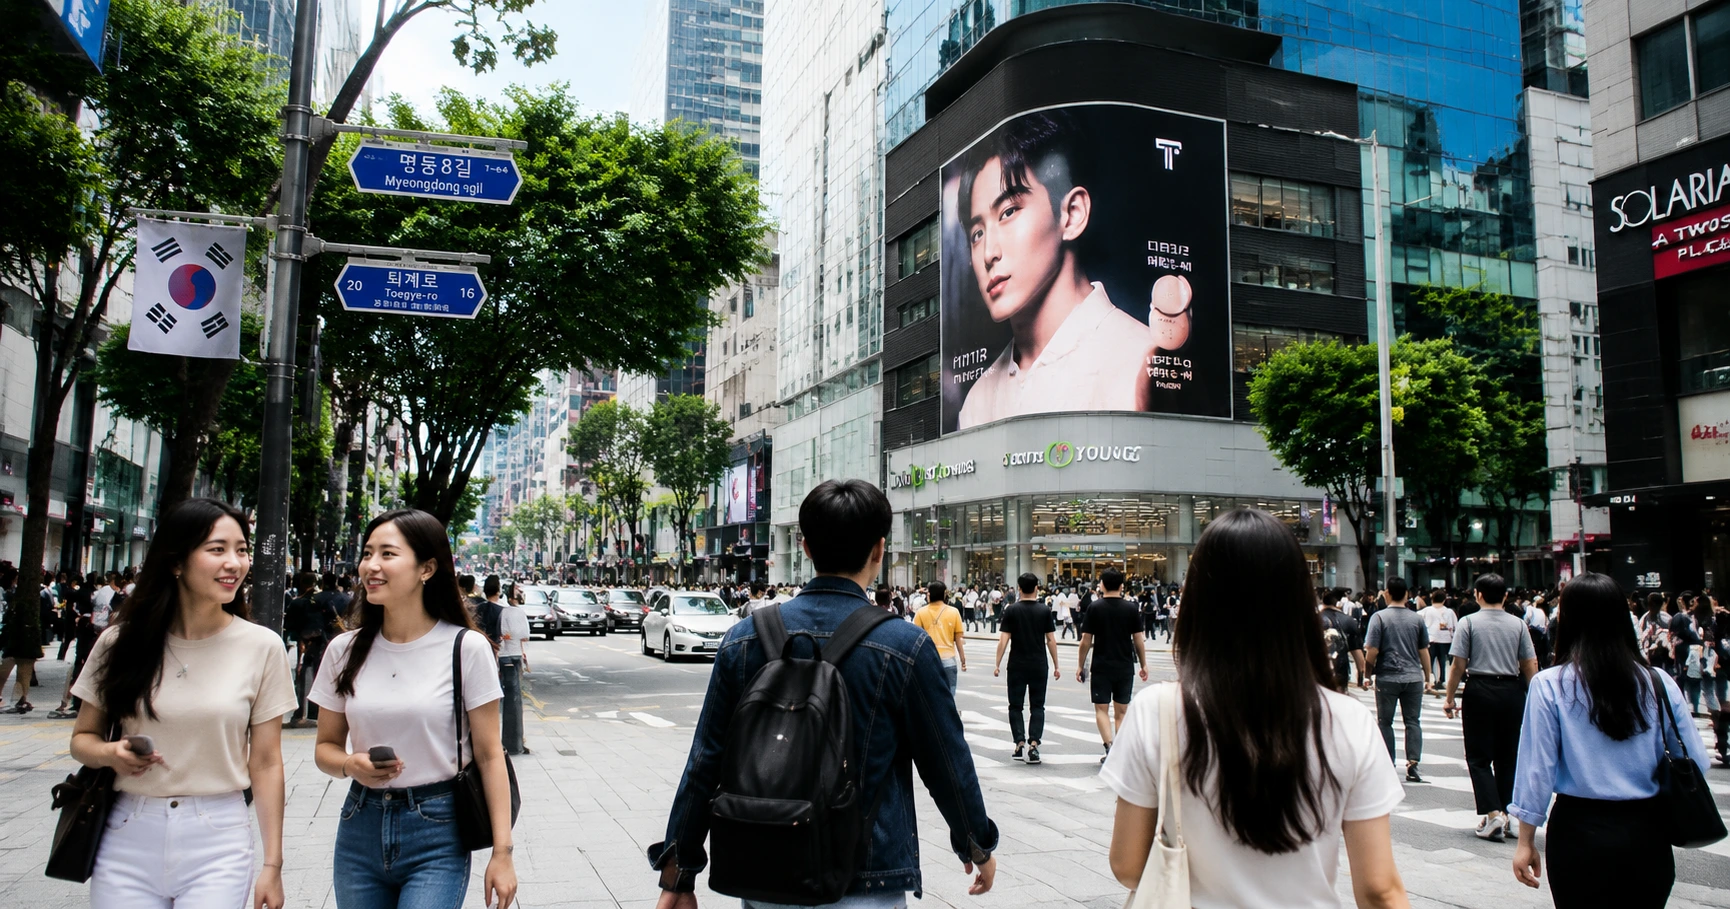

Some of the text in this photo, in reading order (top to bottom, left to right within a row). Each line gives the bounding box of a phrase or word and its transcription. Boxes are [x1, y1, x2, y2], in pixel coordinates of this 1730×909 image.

[384, 174, 460, 196] Myeongdong
[1610, 163, 1730, 232] SOLARIA
[346, 279, 363, 291] 20
[386, 271, 438, 288] 퇴계로
[384, 288, 438, 301] Toegye-ro
[460, 287, 475, 299] 16
